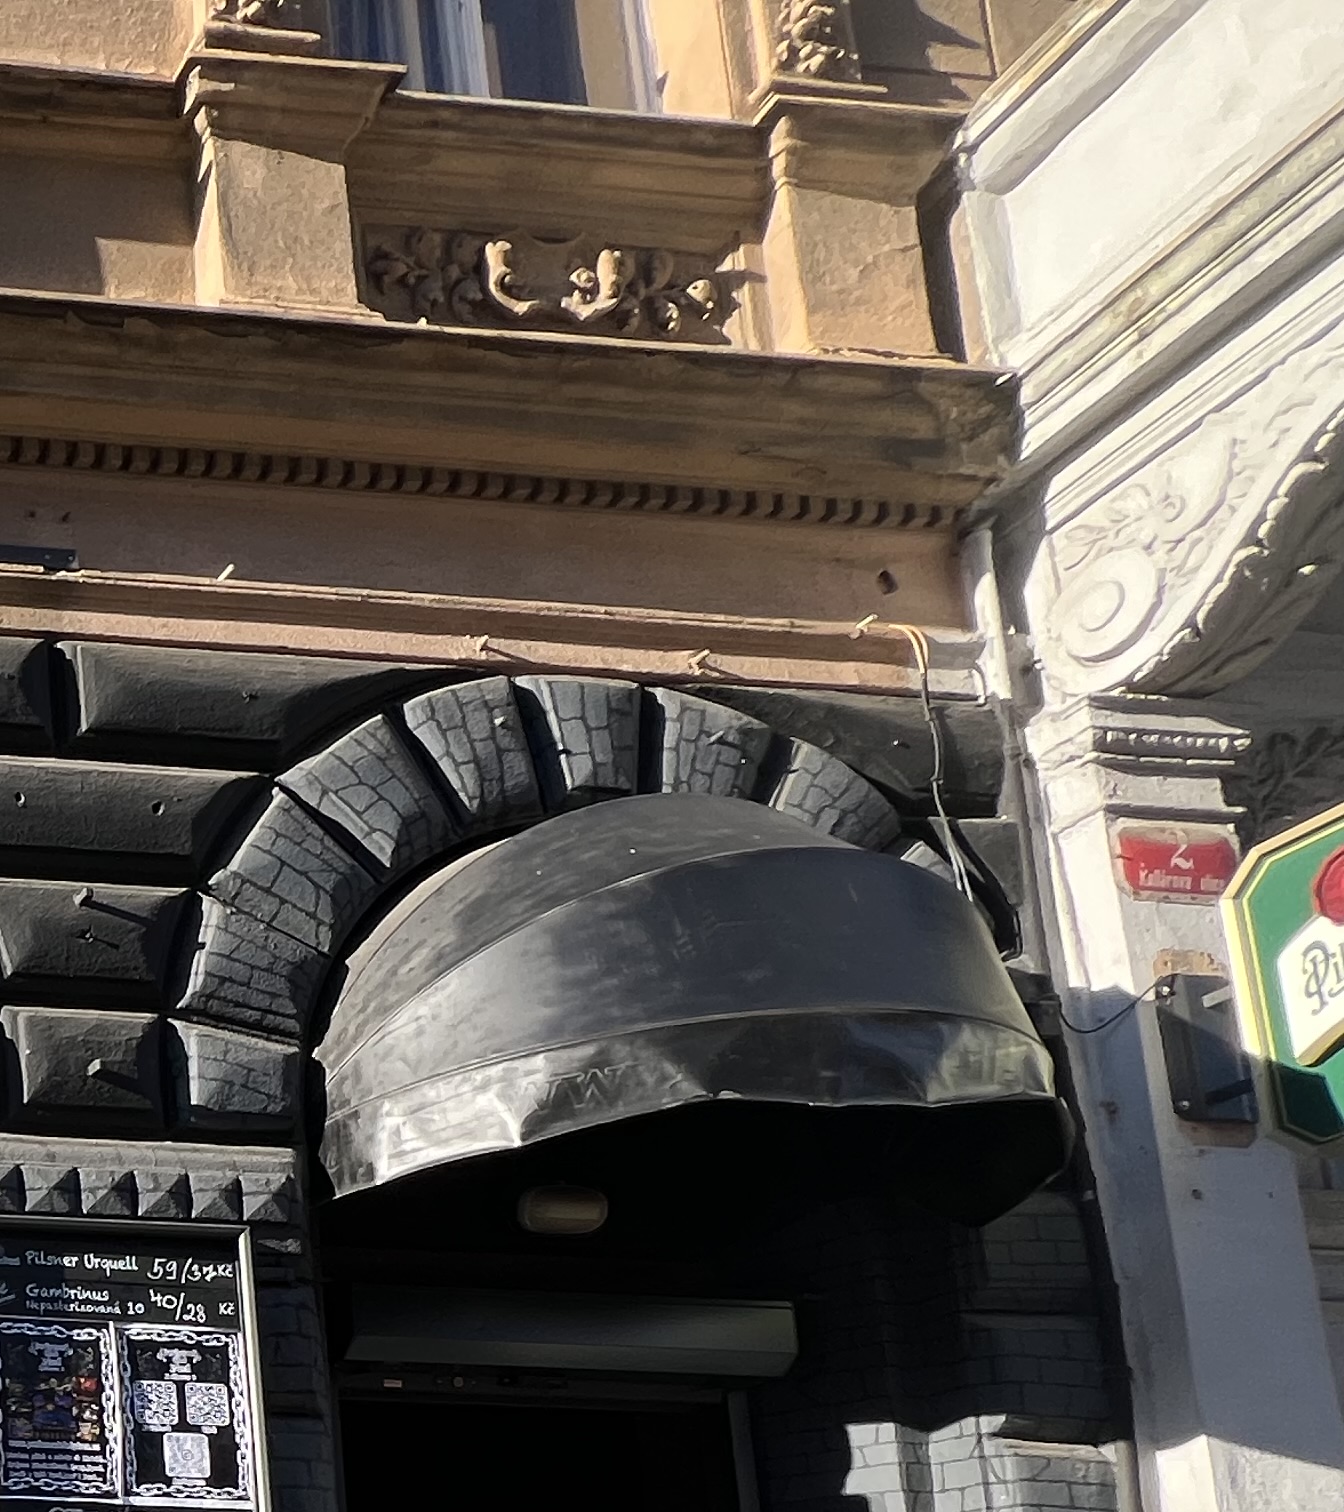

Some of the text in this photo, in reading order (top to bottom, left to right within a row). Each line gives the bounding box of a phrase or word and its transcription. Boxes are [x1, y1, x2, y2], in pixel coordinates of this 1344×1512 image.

[25, 1250, 79, 1268] Pilsner
[84, 1253, 138, 1277] Urquell
[25, 1282, 110, 1301] Gambrinus
[127, 1301, 145, 1315] 10
